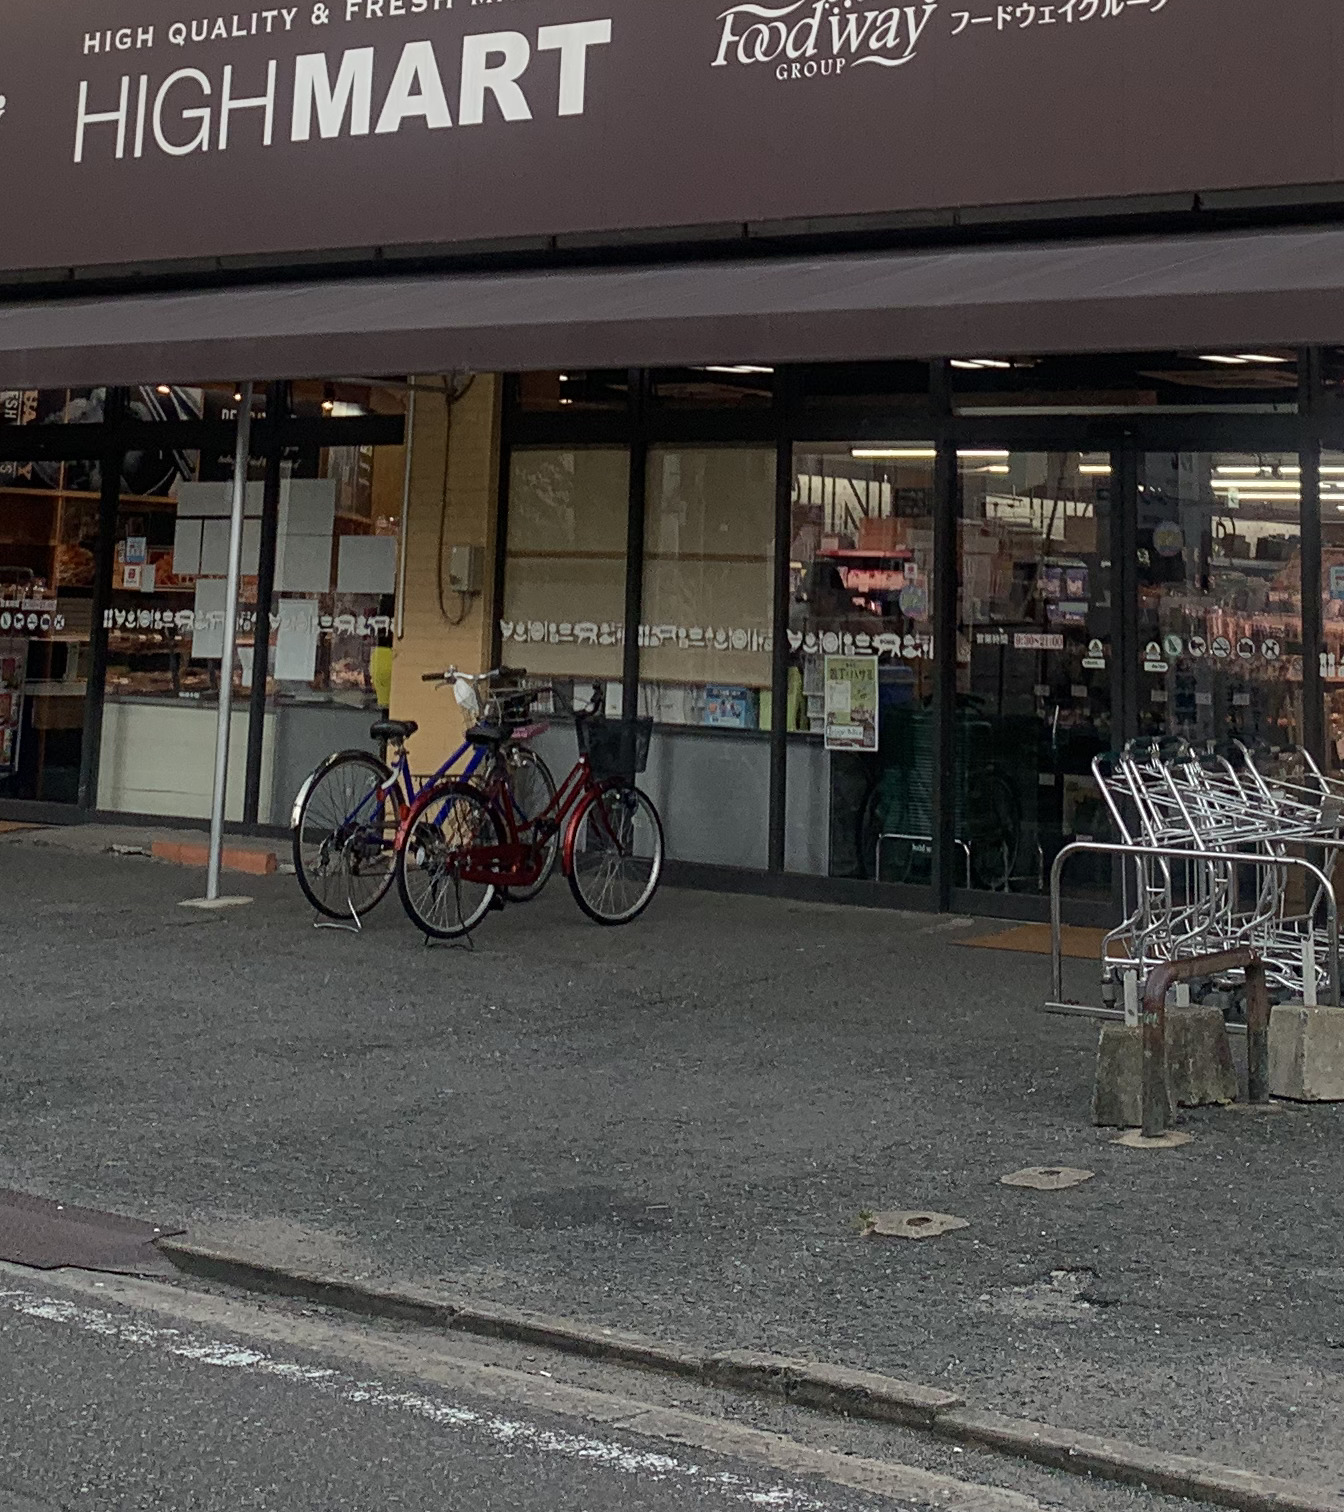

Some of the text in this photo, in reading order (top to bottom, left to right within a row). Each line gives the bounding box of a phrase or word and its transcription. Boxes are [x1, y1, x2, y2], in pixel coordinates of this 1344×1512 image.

[83, 25, 155, 54] HIGH
[168, 7, 298, 47] QUALITY
[311, 3, 330, 26] &
[776, 58, 846, 80] GROUP
